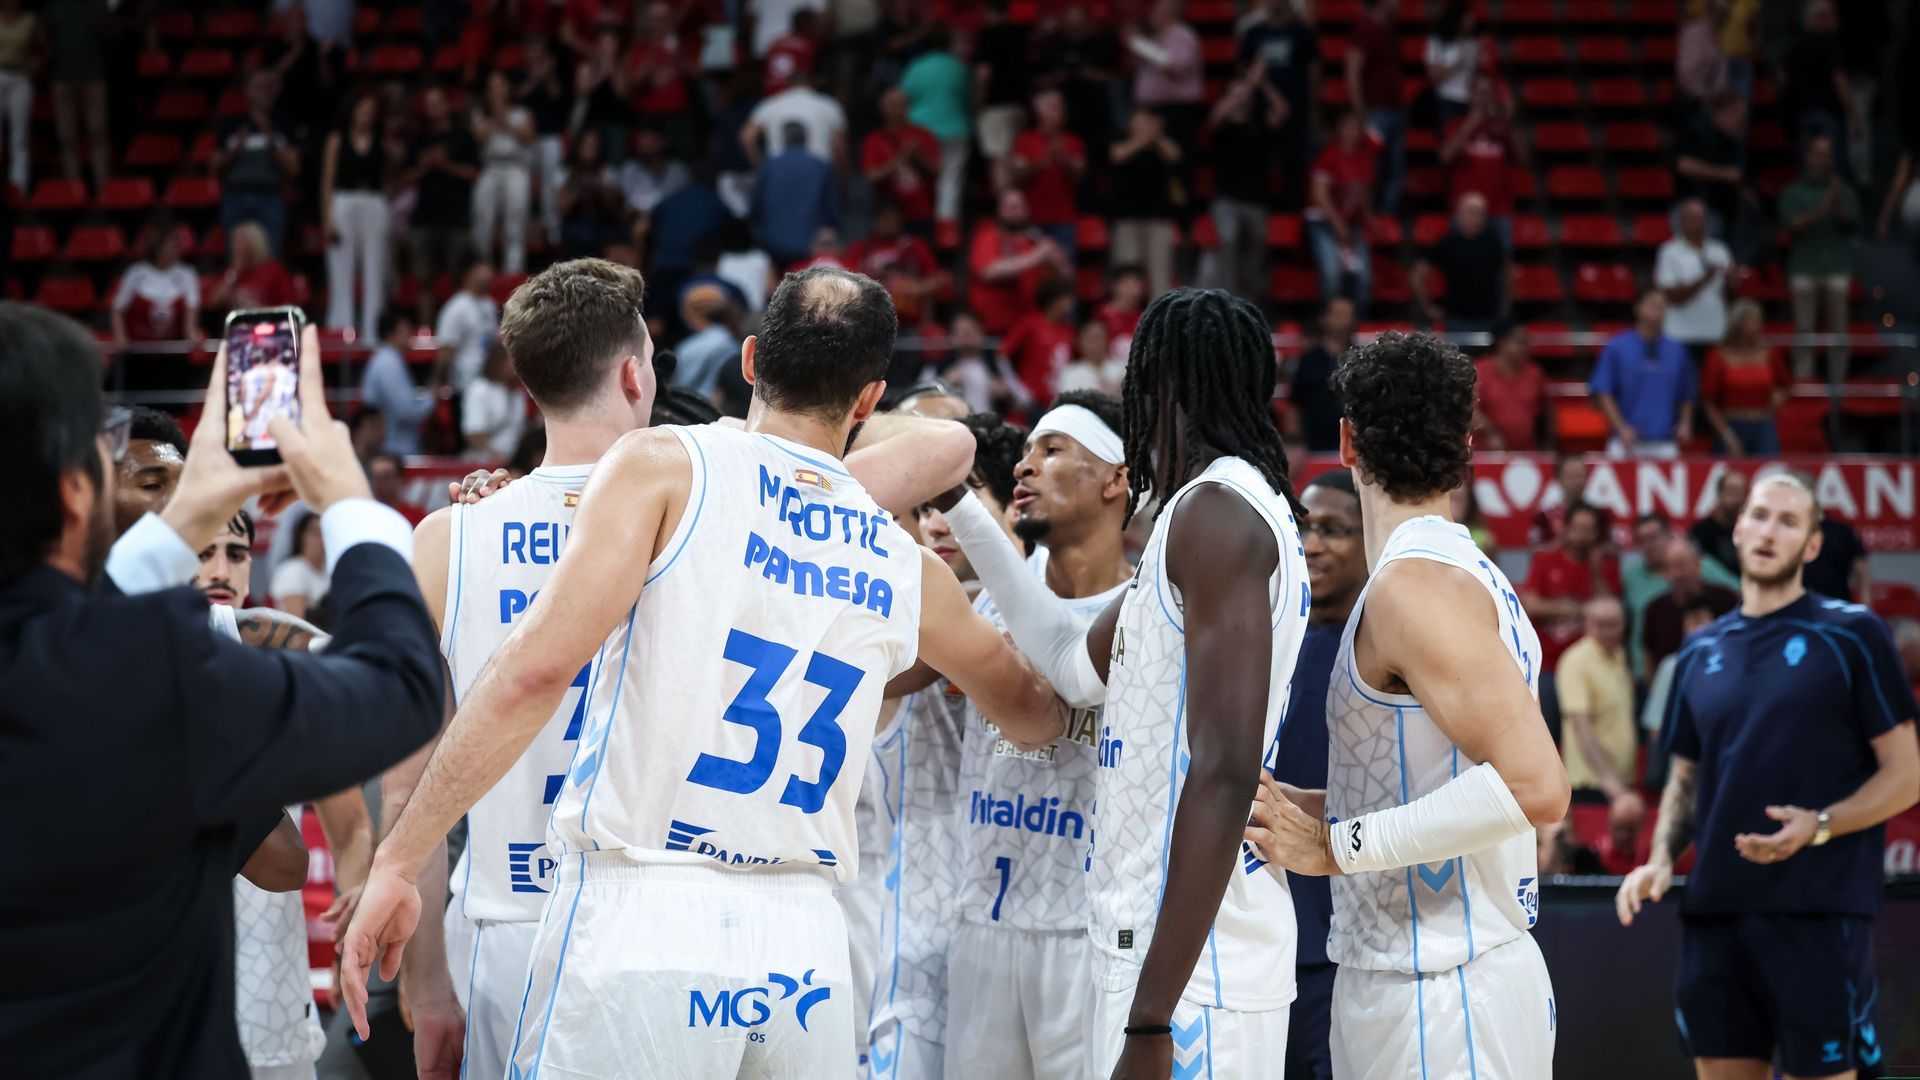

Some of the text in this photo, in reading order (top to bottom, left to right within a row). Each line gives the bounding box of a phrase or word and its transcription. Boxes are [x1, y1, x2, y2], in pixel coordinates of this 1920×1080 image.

[759, 464, 889, 558] MROTIĆ
[744, 531, 893, 619] PAMESA
[686, 628, 866, 814] 33
